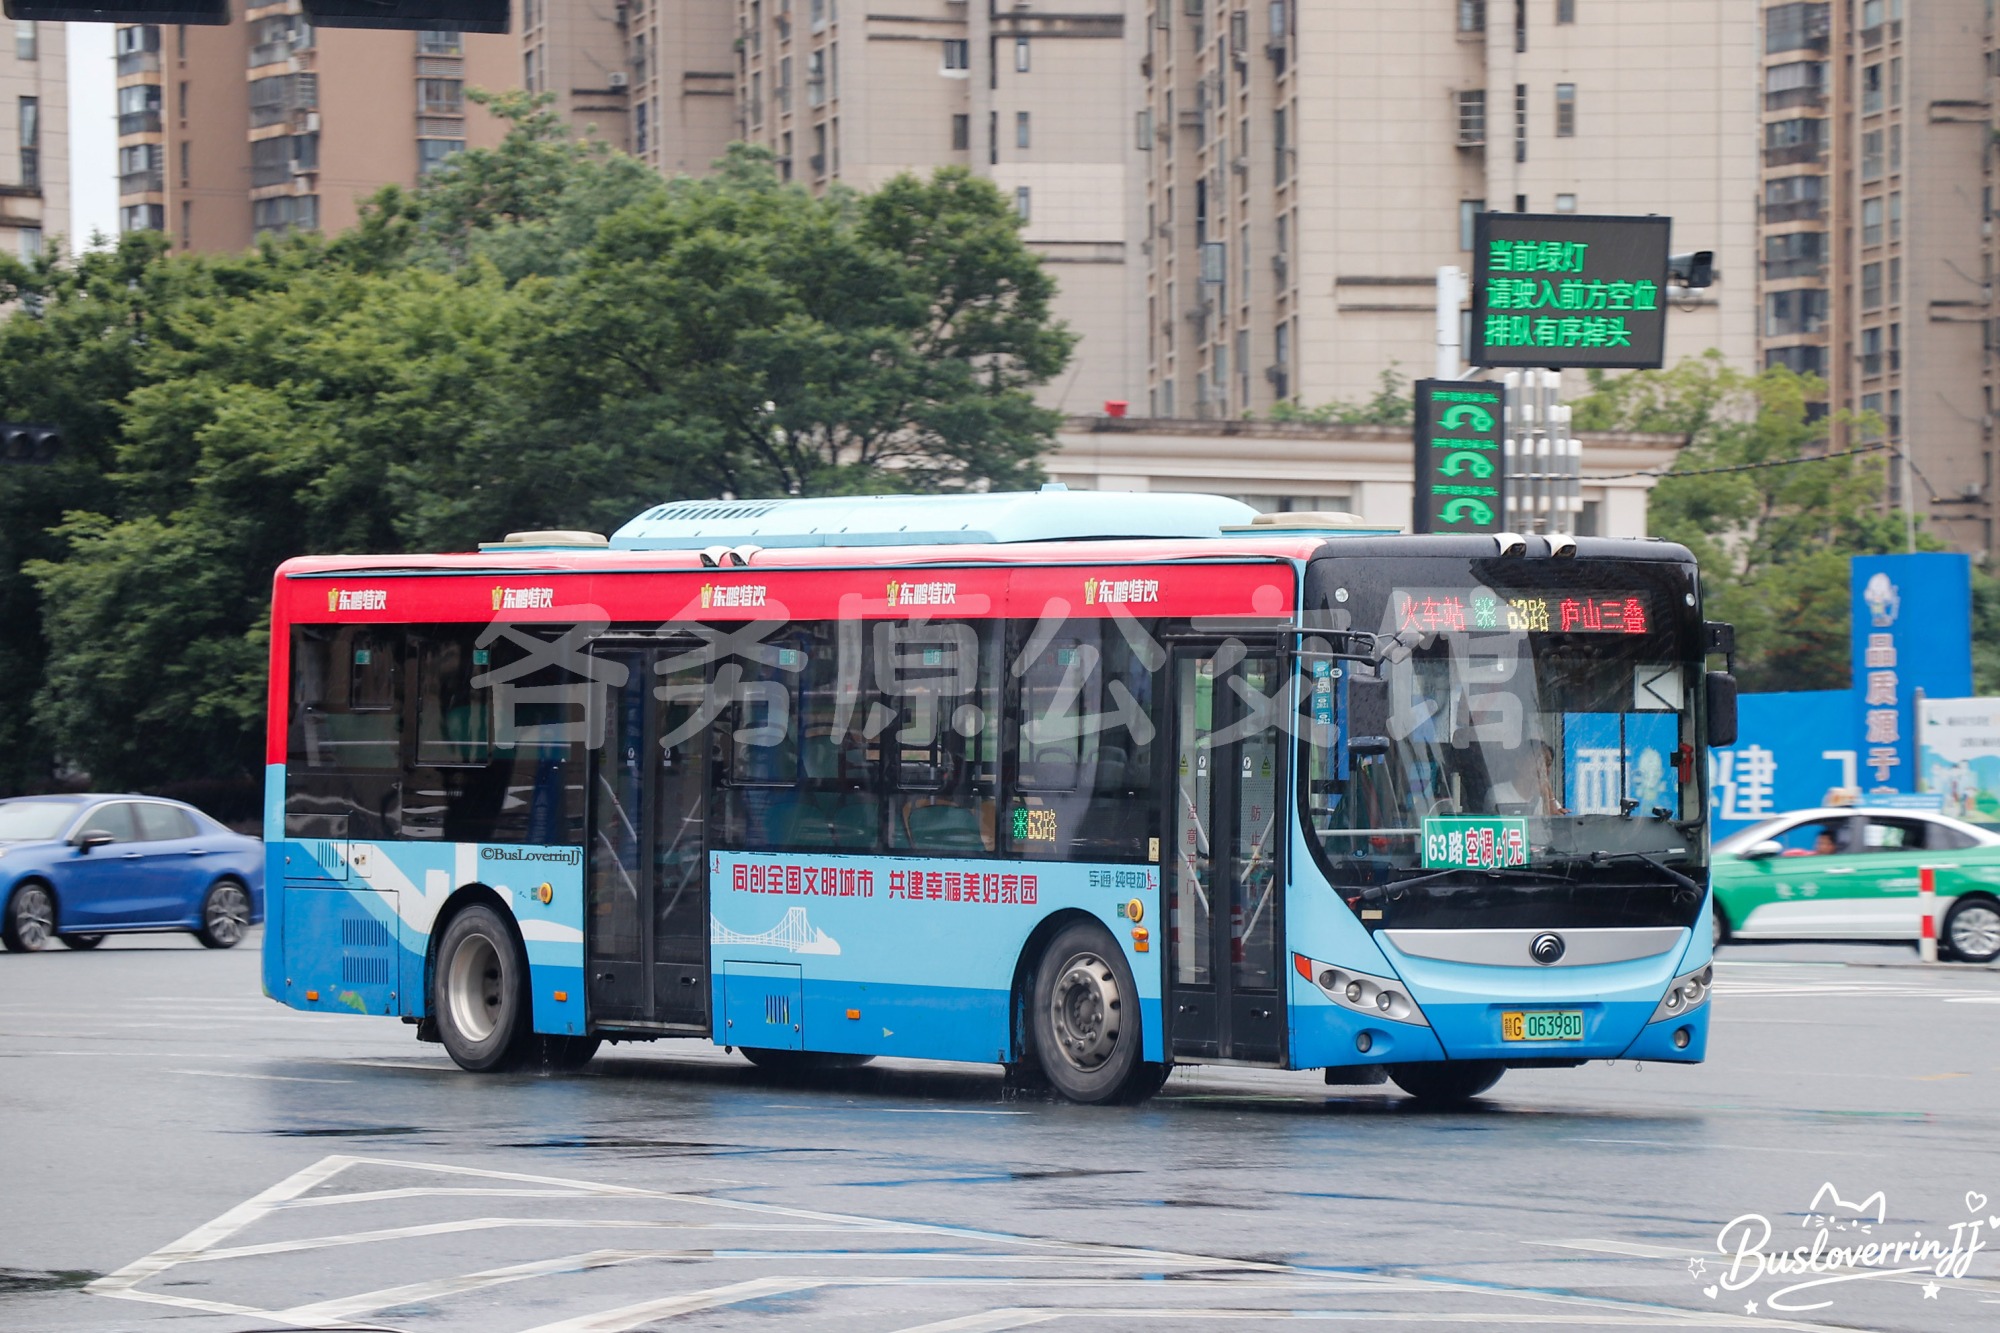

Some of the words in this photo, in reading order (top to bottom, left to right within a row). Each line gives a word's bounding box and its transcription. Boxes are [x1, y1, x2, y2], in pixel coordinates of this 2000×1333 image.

[1489, 240, 1588, 273] 当前绿灯
[1486, 278, 1657, 311] 请驶入前方空位
[1484, 315, 1632, 347] 排队有序掉头
[338, 589, 387, 610] 东鹏特饮
[503, 588, 554, 608] 东鹏特饮
[712, 585, 767, 607] 东鹏特饮
[900, 582, 956, 605] 东鹏特饮
[1098, 579, 1159, 603] 东鹏特饮
[1400, 596, 1466, 632] 火车站
[1560, 597, 1647, 634] 庐山三叠
[1864, 633, 1900, 794] 品质源于
[1028, 809, 1057, 842] 63路
[733, 864, 874, 897] 同创全国文明城市
[889, 870, 1038, 905] 共建幸福美好家园
